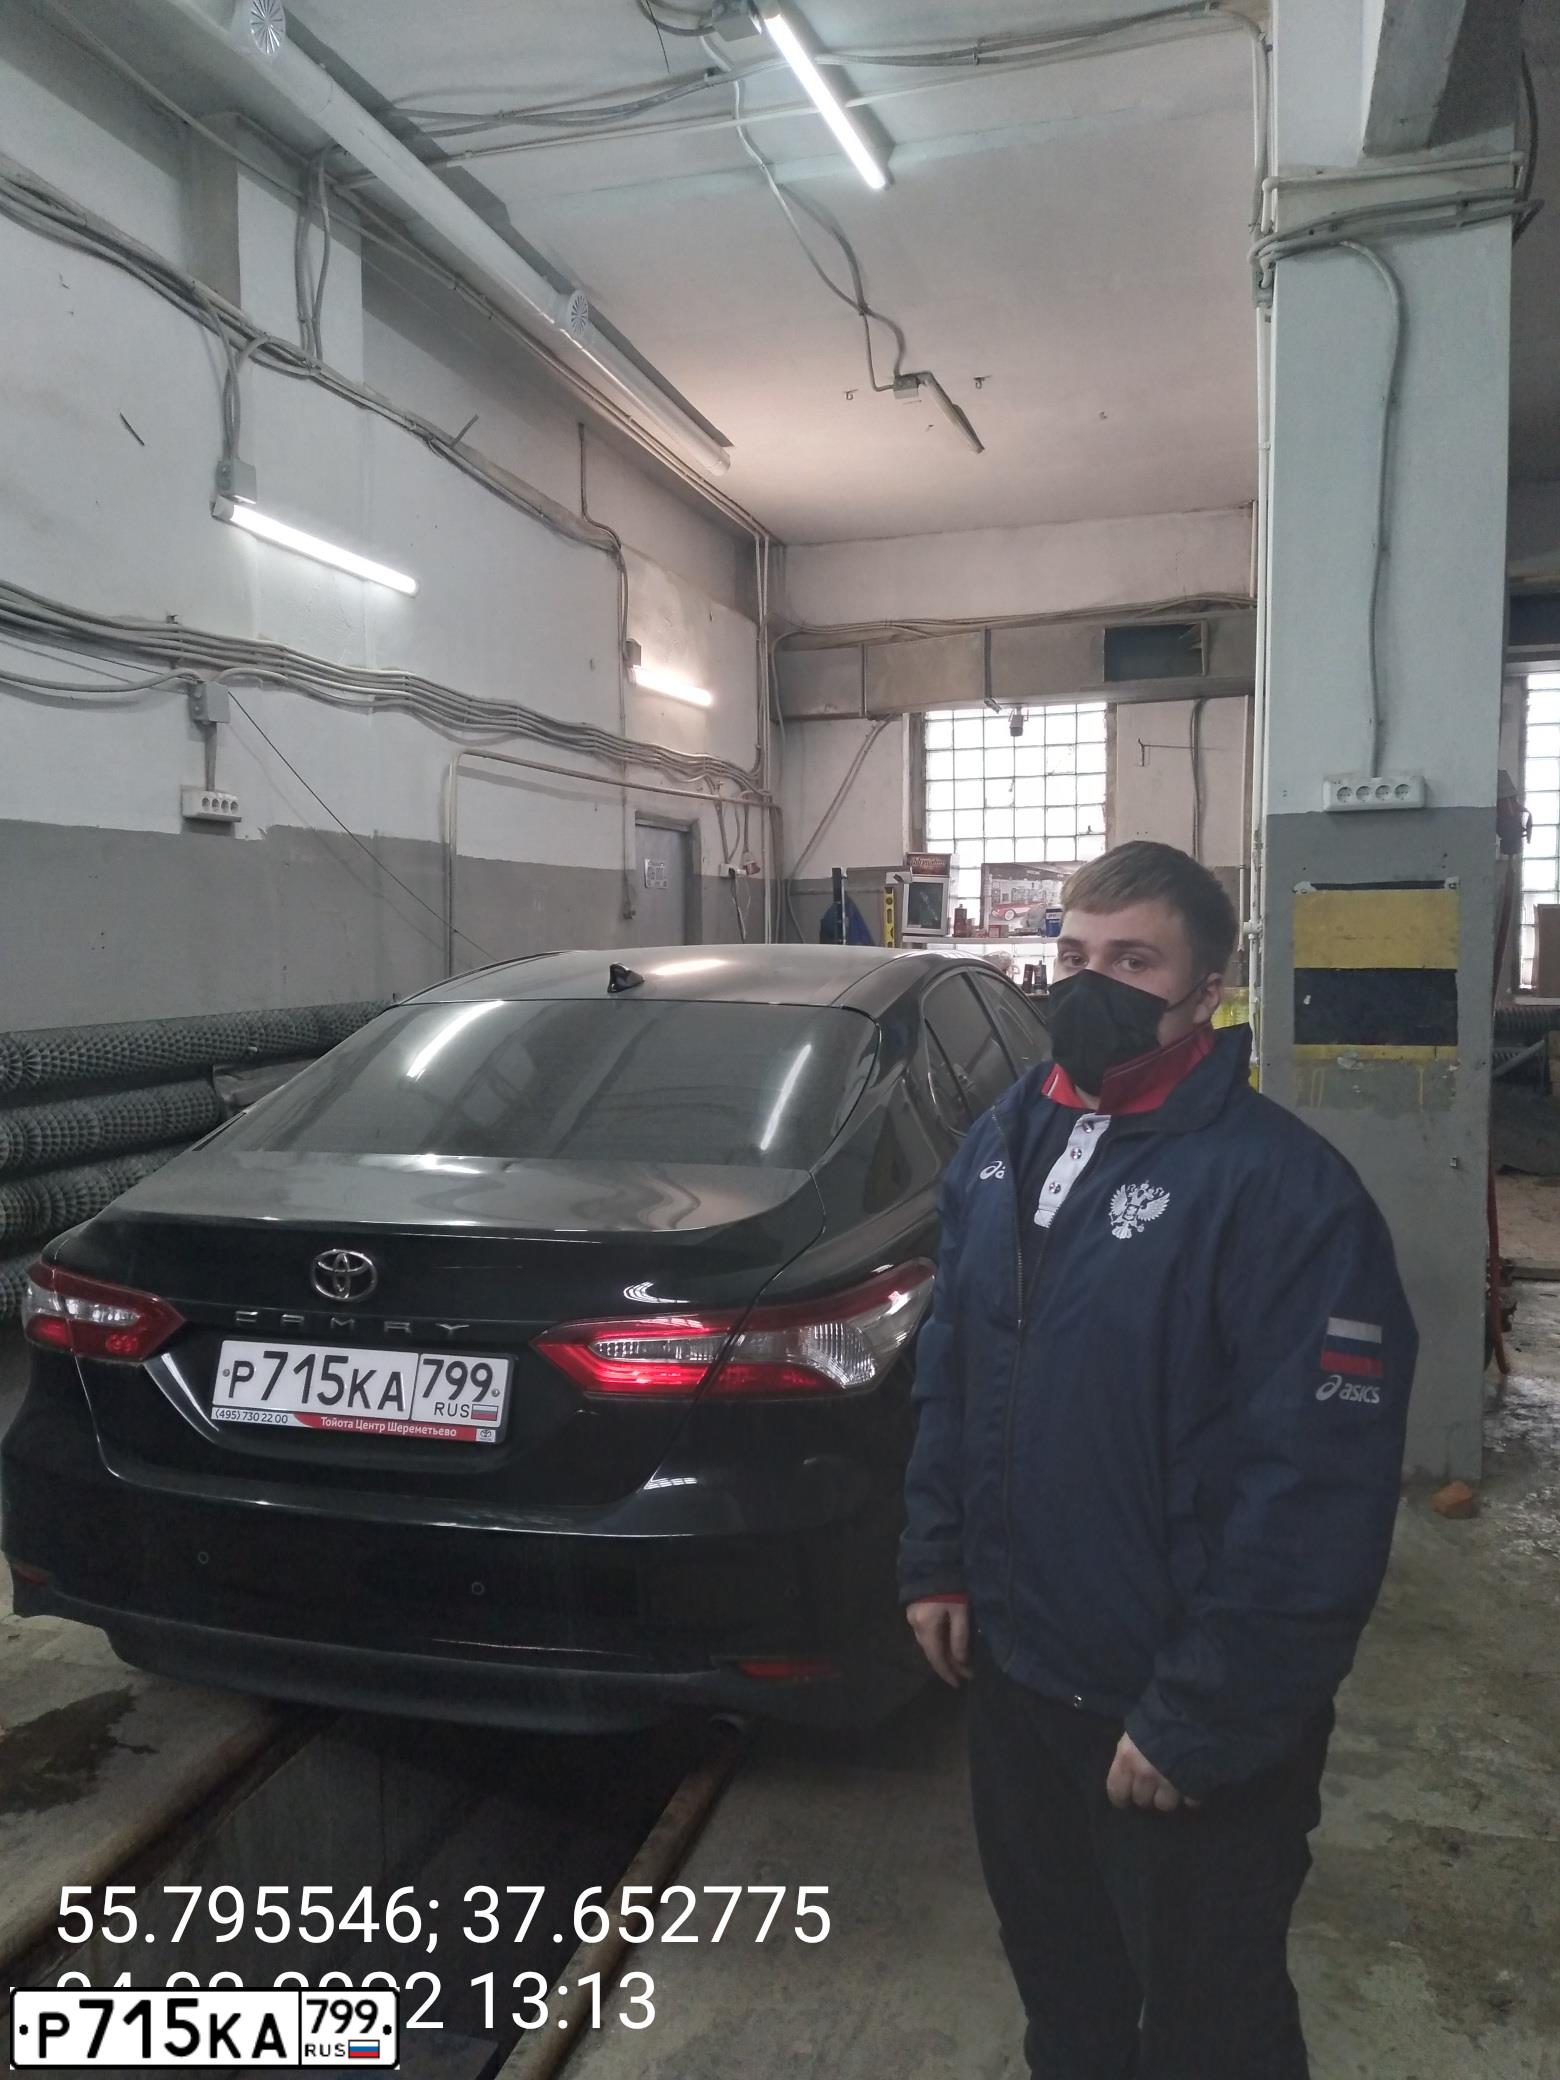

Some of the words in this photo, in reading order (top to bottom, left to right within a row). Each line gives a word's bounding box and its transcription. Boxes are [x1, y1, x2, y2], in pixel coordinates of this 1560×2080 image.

[422, 1359, 493, 1403] 799
[215, 1410, 240, 1420] (495)
[242, 1413, 260, 1422] 730
[262, 1413, 273, 1423] 22
[275, 1414, 288, 1424] 00
[433, 1402, 470, 1418] RUS
[321, 1416, 354, 1429] Тойота
[355, 1421, 386, 1433] Центр
[387, 1422, 457, 1437] Шереметьево
